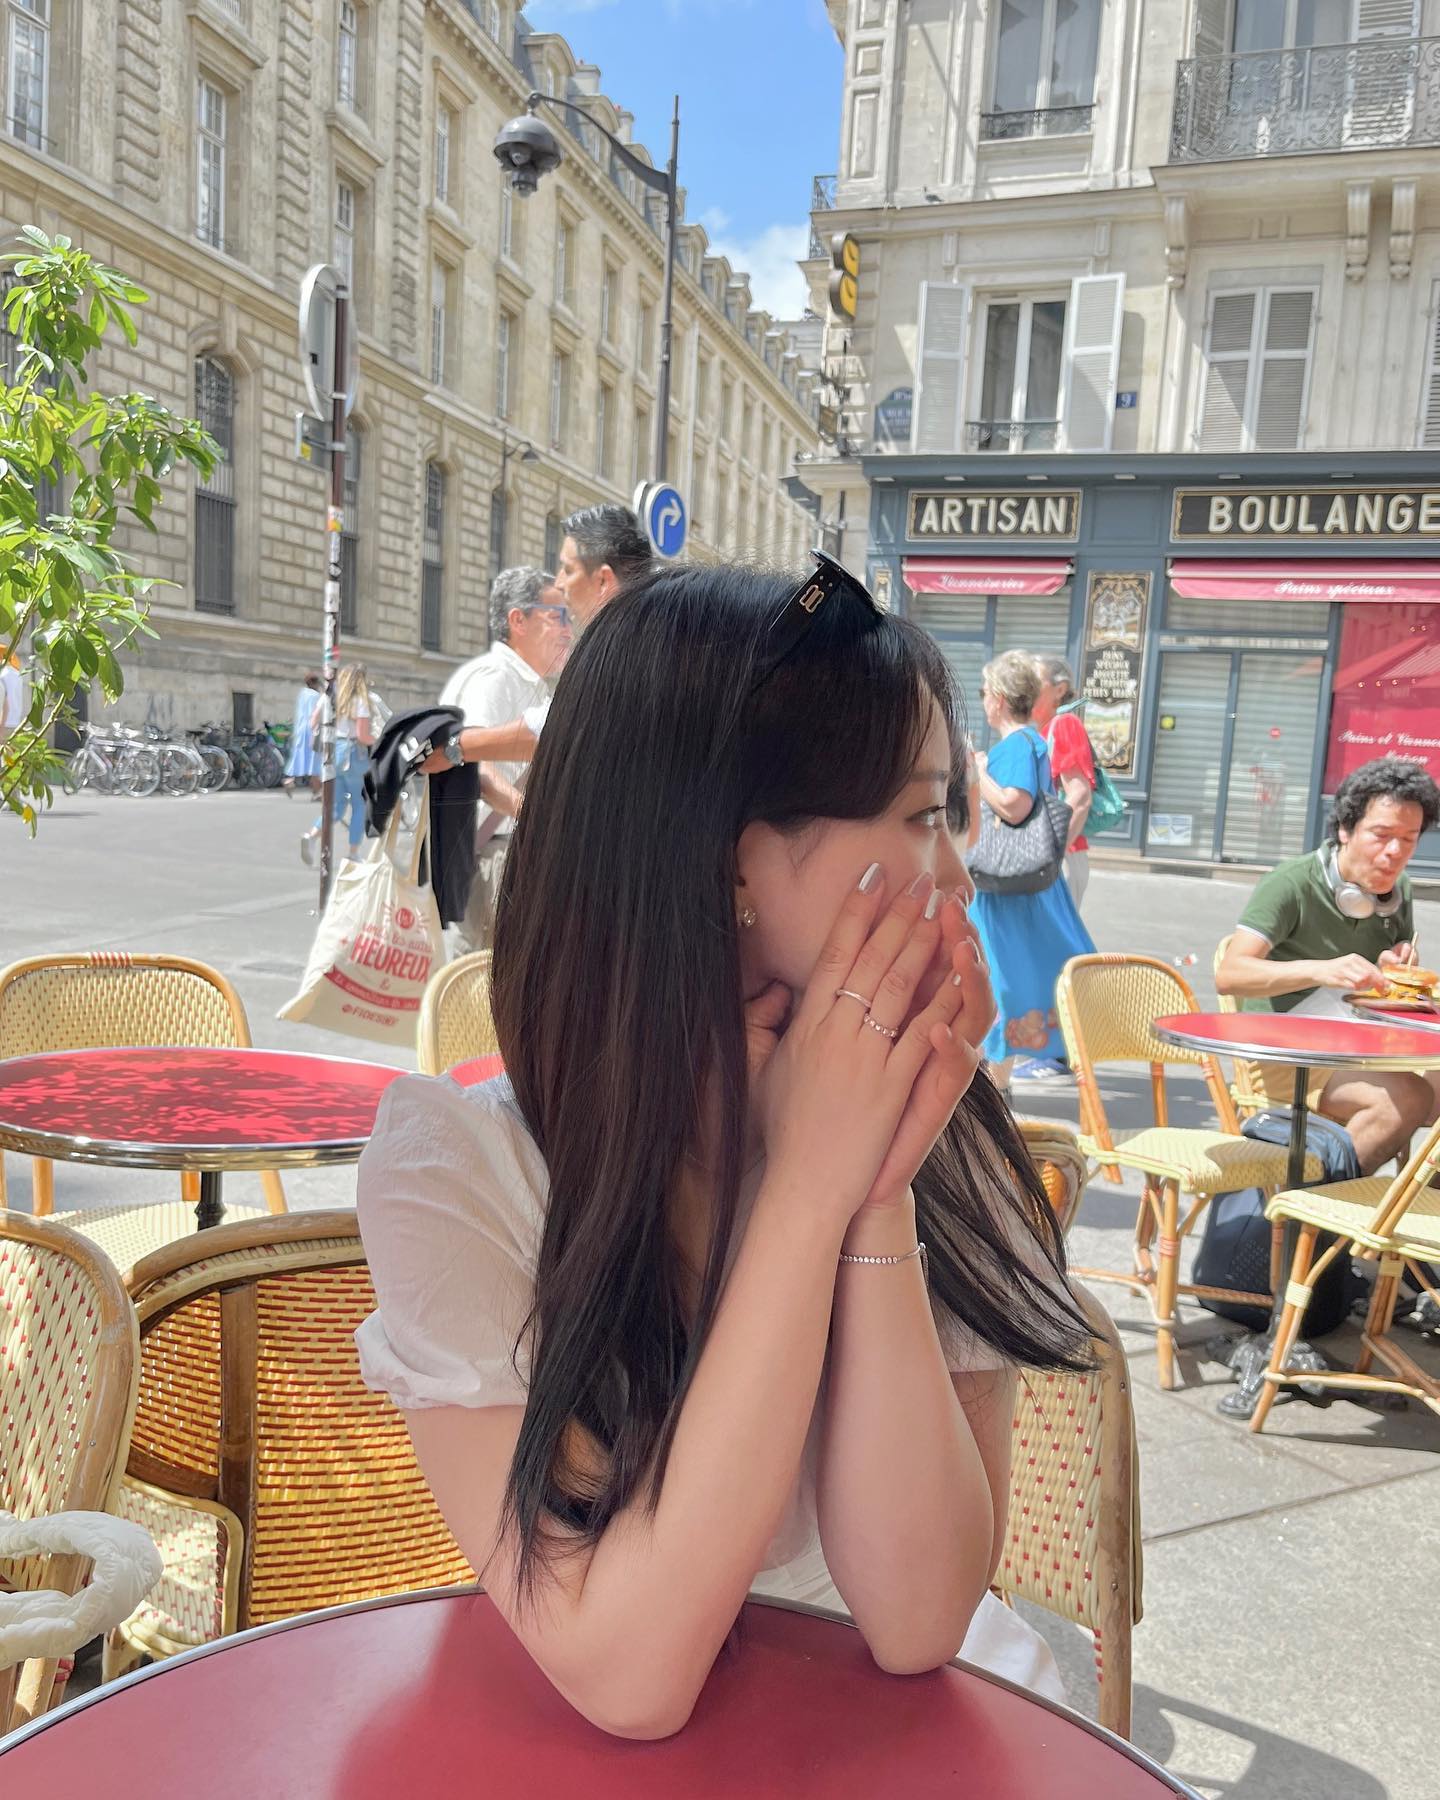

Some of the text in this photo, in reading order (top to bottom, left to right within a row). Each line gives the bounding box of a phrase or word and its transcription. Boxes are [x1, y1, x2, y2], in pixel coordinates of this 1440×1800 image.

[919, 497, 1067, 534] ARTISAN
[1208, 494, 1440, 534] BOULANGE
[1274, 581, 1322, 595] Pains
[351, 934, 433, 985] HEUREUX
